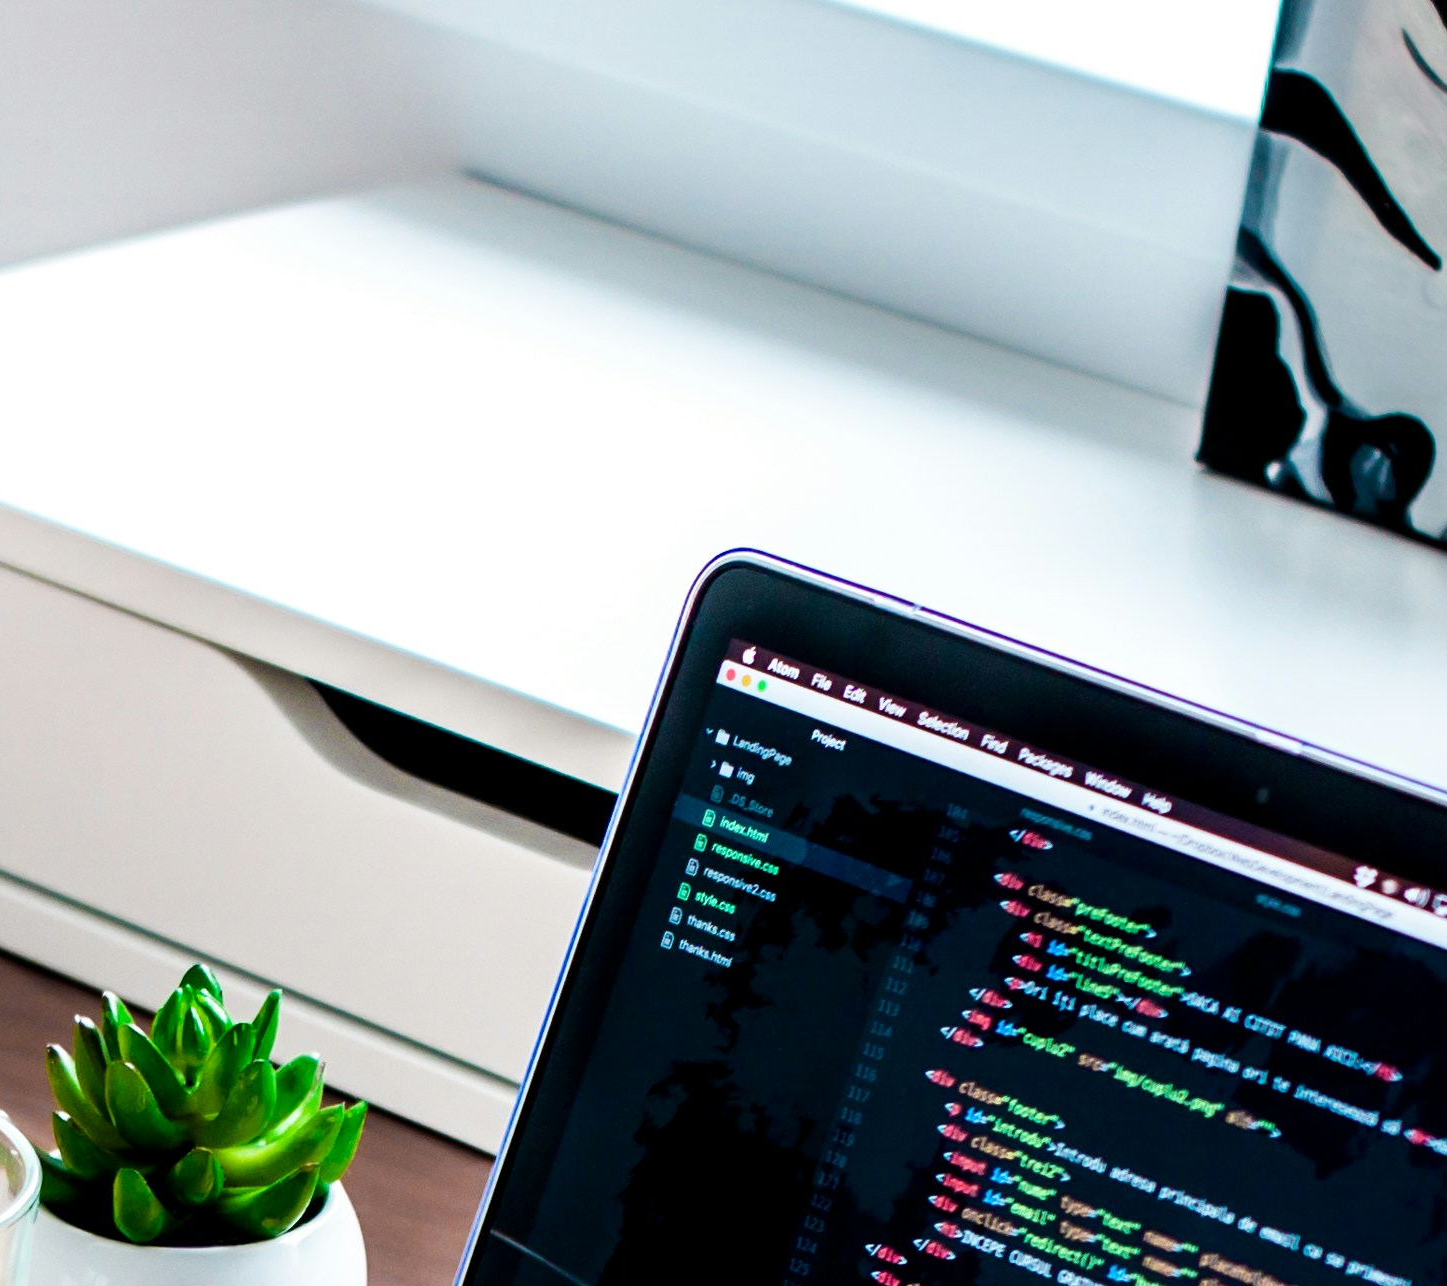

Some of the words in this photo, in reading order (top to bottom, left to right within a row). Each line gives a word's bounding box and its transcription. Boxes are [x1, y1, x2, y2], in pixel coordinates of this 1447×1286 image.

[767, 658, 800, 679] Atom
[810, 672, 832, 691] File
[842, 684, 867, 704] Edit
[879, 697, 907, 717] View
[916, 711, 969, 740] Selection
[980, 734, 1009, 754] Find
[1017, 747, 1073, 778] Packages
[1084, 771, 1131, 798] Window
[1141, 792, 1172, 814] Help
[810, 729, 846, 751] Project
[732, 735, 792, 766] LandingPage
[736, 767, 755, 785] img
[729, 793, 773, 818] .DS_Store
[719, 815, 769, 843] index.html
[1008, 829, 1053, 850] </div>
[711, 843, 779, 875] responsive.css
[703, 867, 776, 902] responsive2.css
[993, 873, 1023, 890] <div
[694, 892, 735, 914] style.css
[999, 900, 1030, 917] <div
[687, 915, 735, 941] thanks.css
[678, 939, 732, 967] thanks.html
[1011, 955, 1042, 971] <div
[968, 988, 1012, 1009] </div>
[961, 1010, 991, 1030] <img
[940, 1026, 983, 1048] </div>
[1078, 1004, 1118, 1027] place
[1121, 1021, 1147, 1038] cum
[1242, 1066, 1268, 1085] ori
[925, 1070, 954, 1087] <div
[959, 1082, 1065, 1130] class="footer">
[936, 1124, 967, 1141] <div
[971, 1137, 1070, 1182] class="trei2">
[944, 1102, 961, 1116] <p
[1109, 1167, 1156, 1193] adresa
[943, 1151, 986, 1175] <input
[935, 1173, 979, 1197] <input
[927, 1195, 957, 1212] <div
[864, 1244, 907, 1265] </div>
[912, 1238, 956, 1260] </div>
